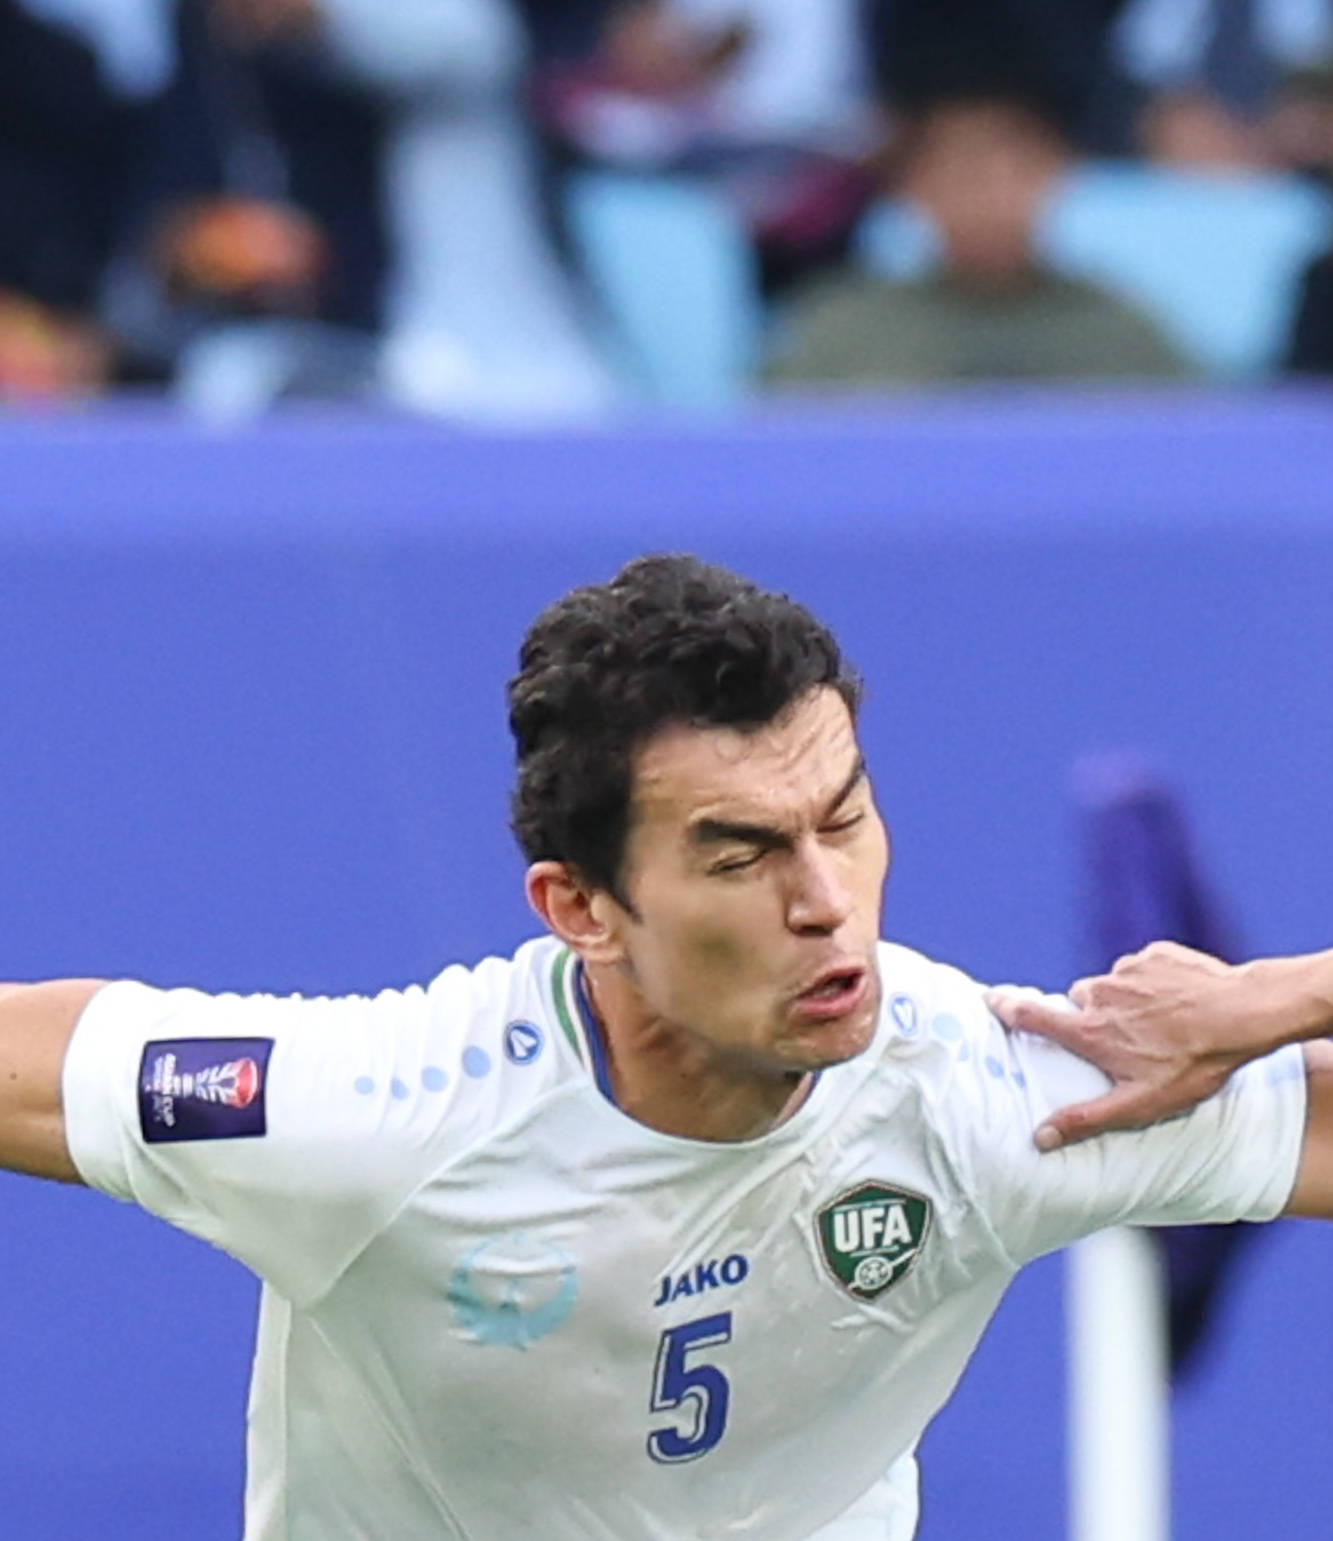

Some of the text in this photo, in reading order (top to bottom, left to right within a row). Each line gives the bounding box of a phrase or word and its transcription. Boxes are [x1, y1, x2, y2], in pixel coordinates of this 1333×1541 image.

[833, 1203, 912, 1253] UFA
[654, 1253, 750, 1308] JAKO
[647, 1311, 732, 1465] 5
